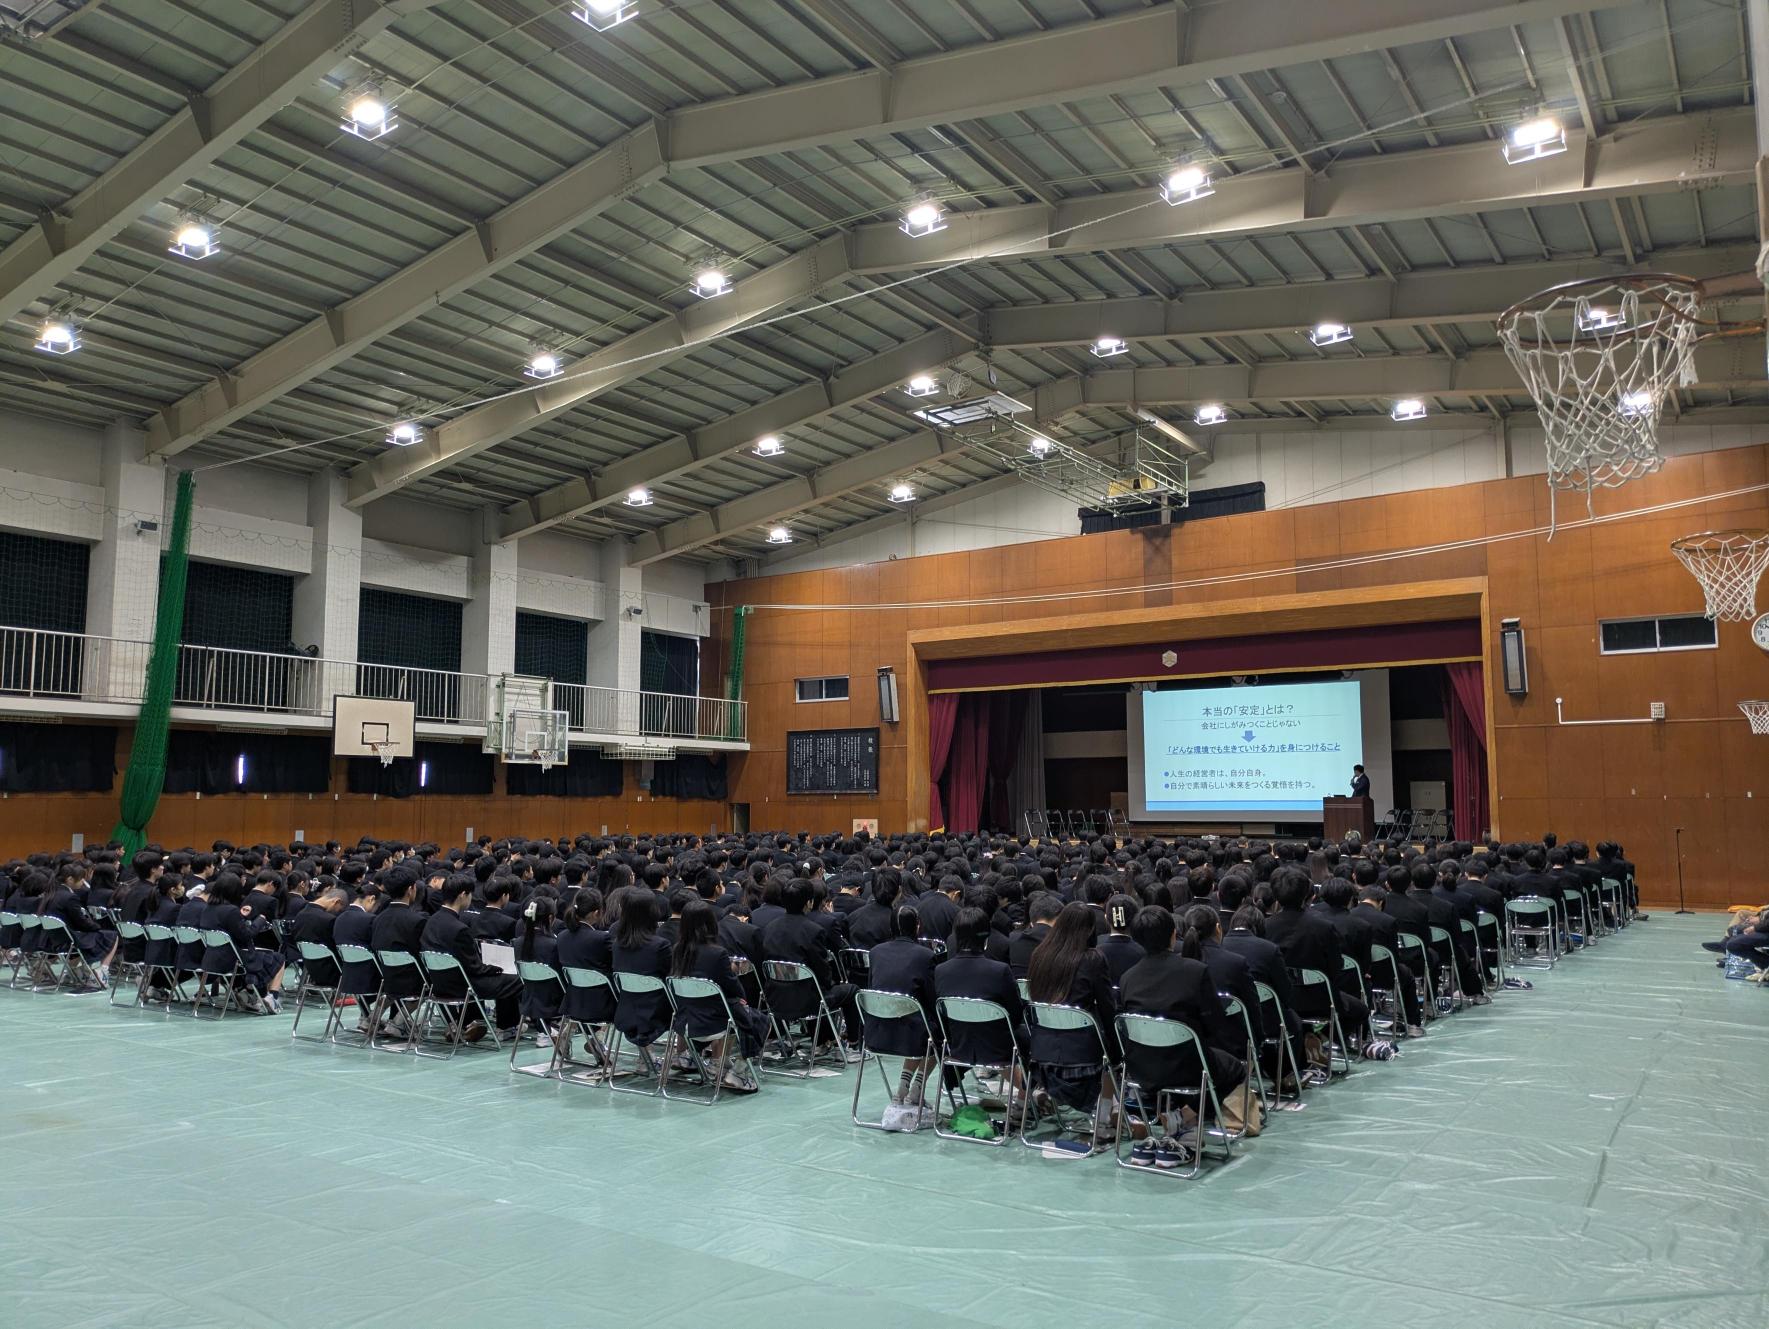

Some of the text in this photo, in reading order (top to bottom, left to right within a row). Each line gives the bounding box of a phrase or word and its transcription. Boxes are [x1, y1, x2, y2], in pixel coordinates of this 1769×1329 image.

[1202, 704, 1294, 717] 本当の「安定」とは？
[1201, 720, 1301, 730] 会社にしがみつくことじゃない
[1168, 742, 1341, 755] 「どんな環境でも生きていける力」を身につけること
